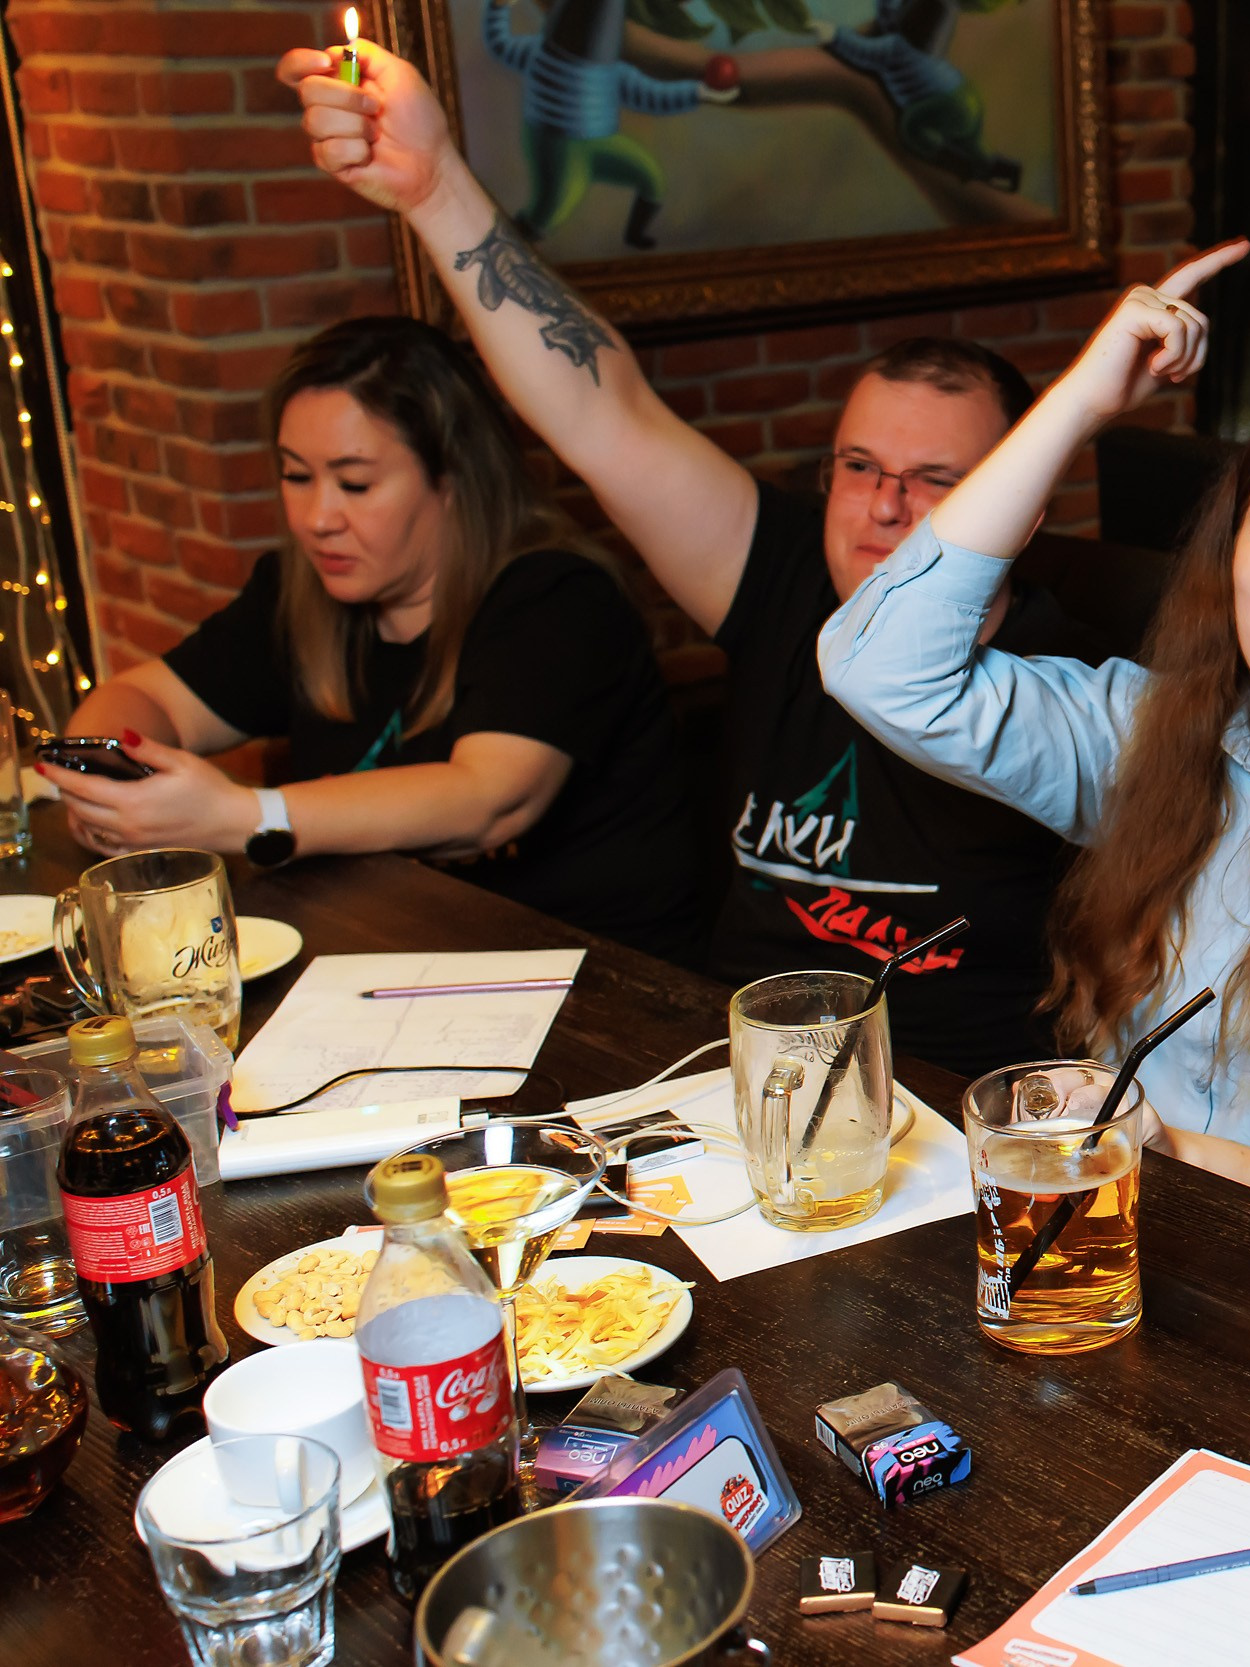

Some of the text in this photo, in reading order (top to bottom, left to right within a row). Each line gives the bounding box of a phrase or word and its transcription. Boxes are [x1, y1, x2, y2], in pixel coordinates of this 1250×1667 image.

[568, 1449, 607, 1465] neo
[900, 1442, 939, 1463] neo
[913, 1472, 943, 1492] neo
[726, 1486, 751, 1514] QUIZ
